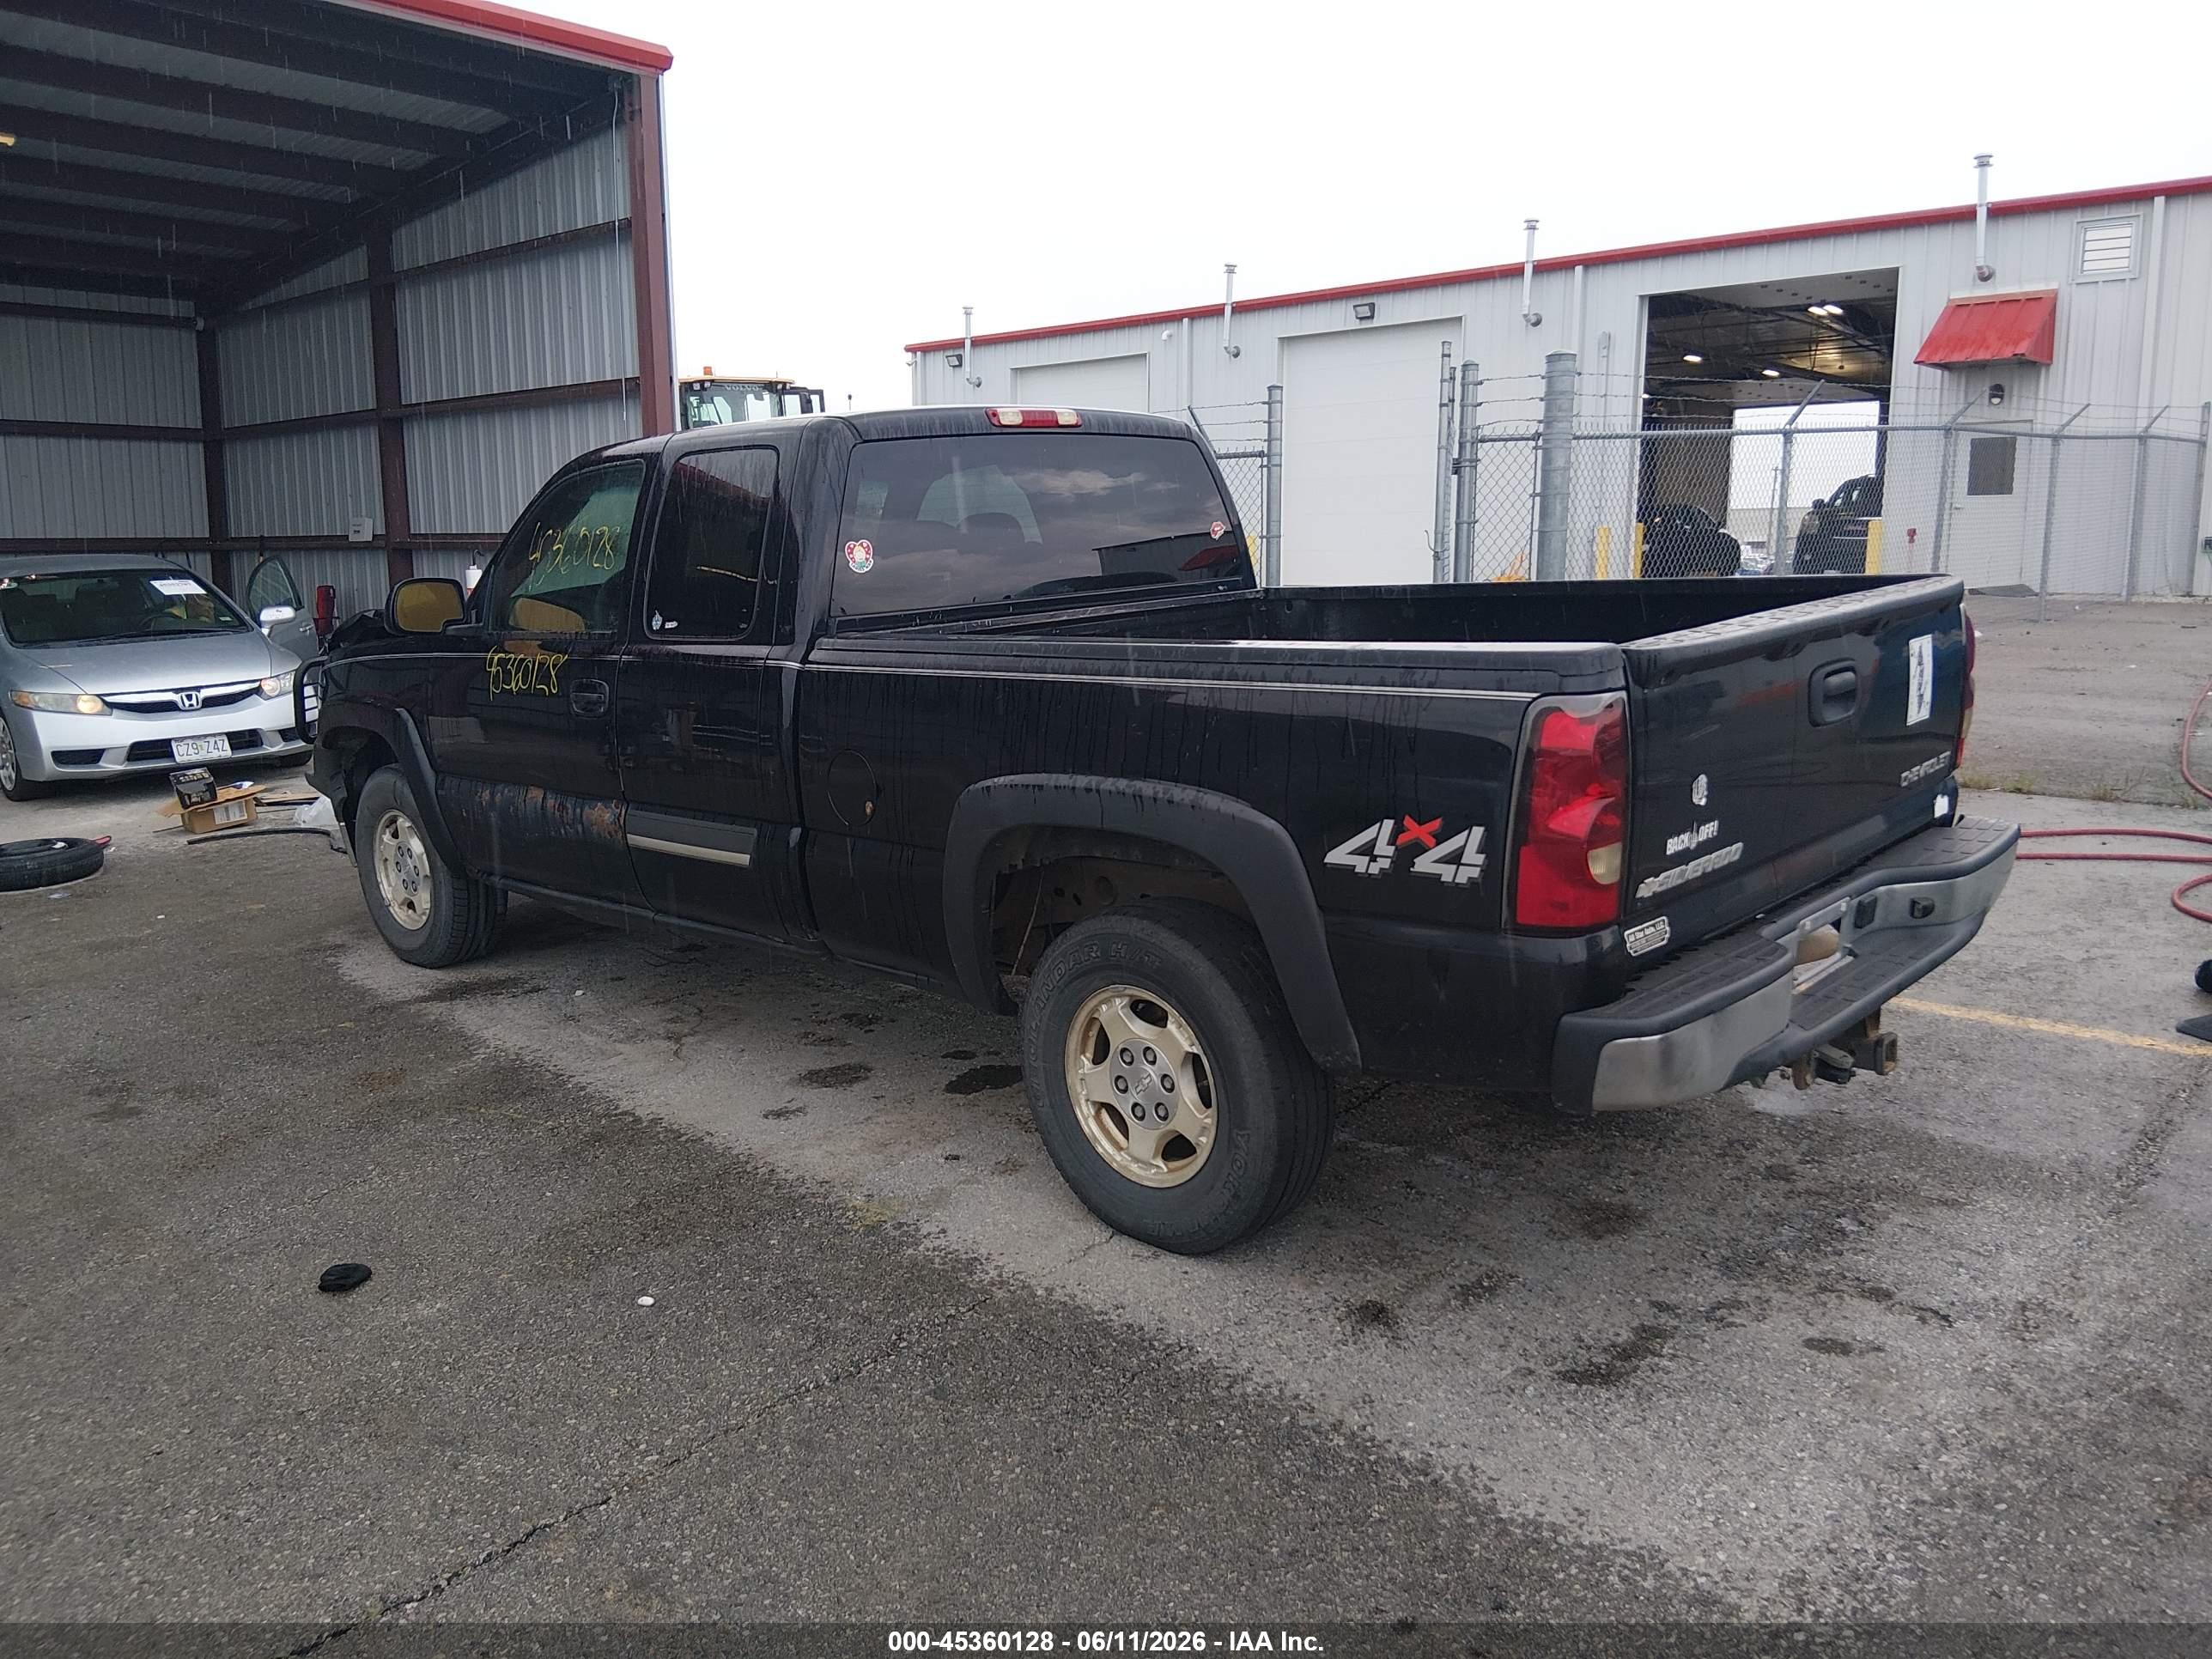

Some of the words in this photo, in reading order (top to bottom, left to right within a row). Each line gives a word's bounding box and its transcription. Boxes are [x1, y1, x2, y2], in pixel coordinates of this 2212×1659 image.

[486, 645, 568, 701] 45360128
[176, 743, 199, 757] CZ9
[1667, 831, 1690, 855] BACK
[1698, 820, 1719, 842] OFF!
[1655, 842, 1743, 893] SILVERADO
